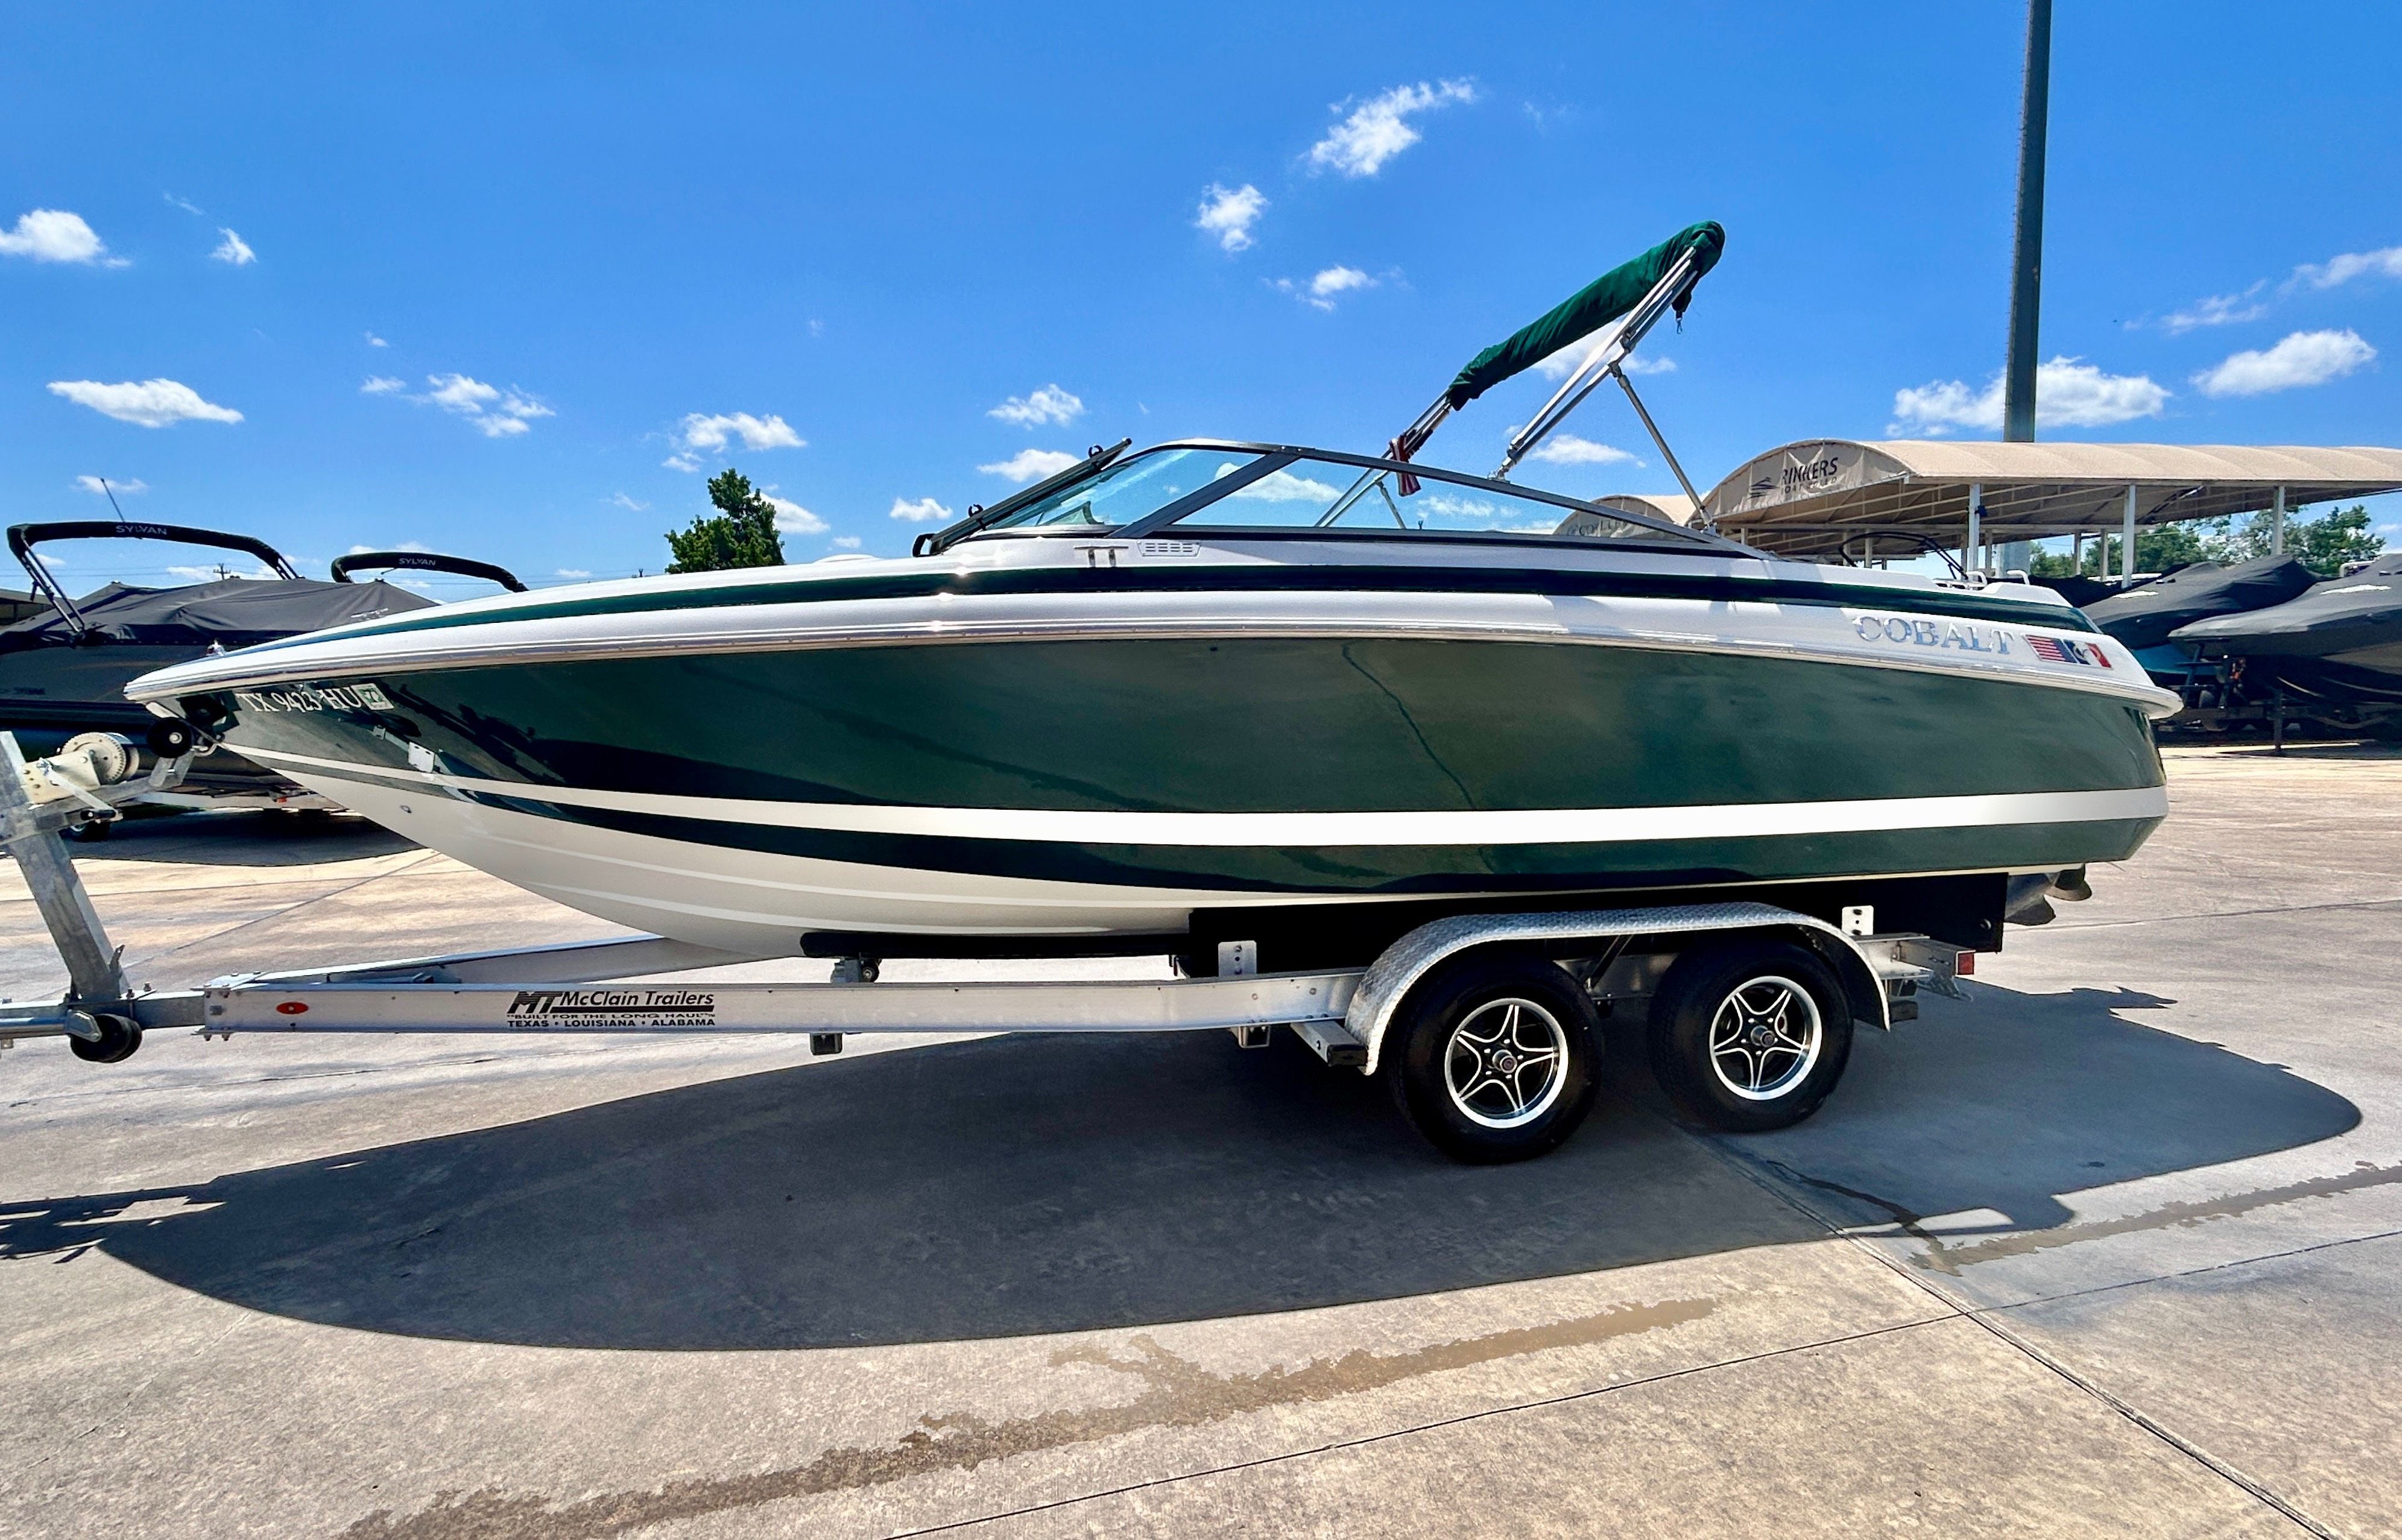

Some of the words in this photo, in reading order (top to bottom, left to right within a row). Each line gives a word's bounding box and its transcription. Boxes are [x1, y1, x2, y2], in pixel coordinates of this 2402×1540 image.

[116, 525, 167, 535] SYLVAN
[1853, 616, 2015, 654] COBALT
[235, 693, 280, 712] TX
[271, 692, 323, 713] 9423
[316, 687, 362, 710] HU
[560, 991, 639, 1005] McClain
[645, 991, 714, 1005] Trailers
